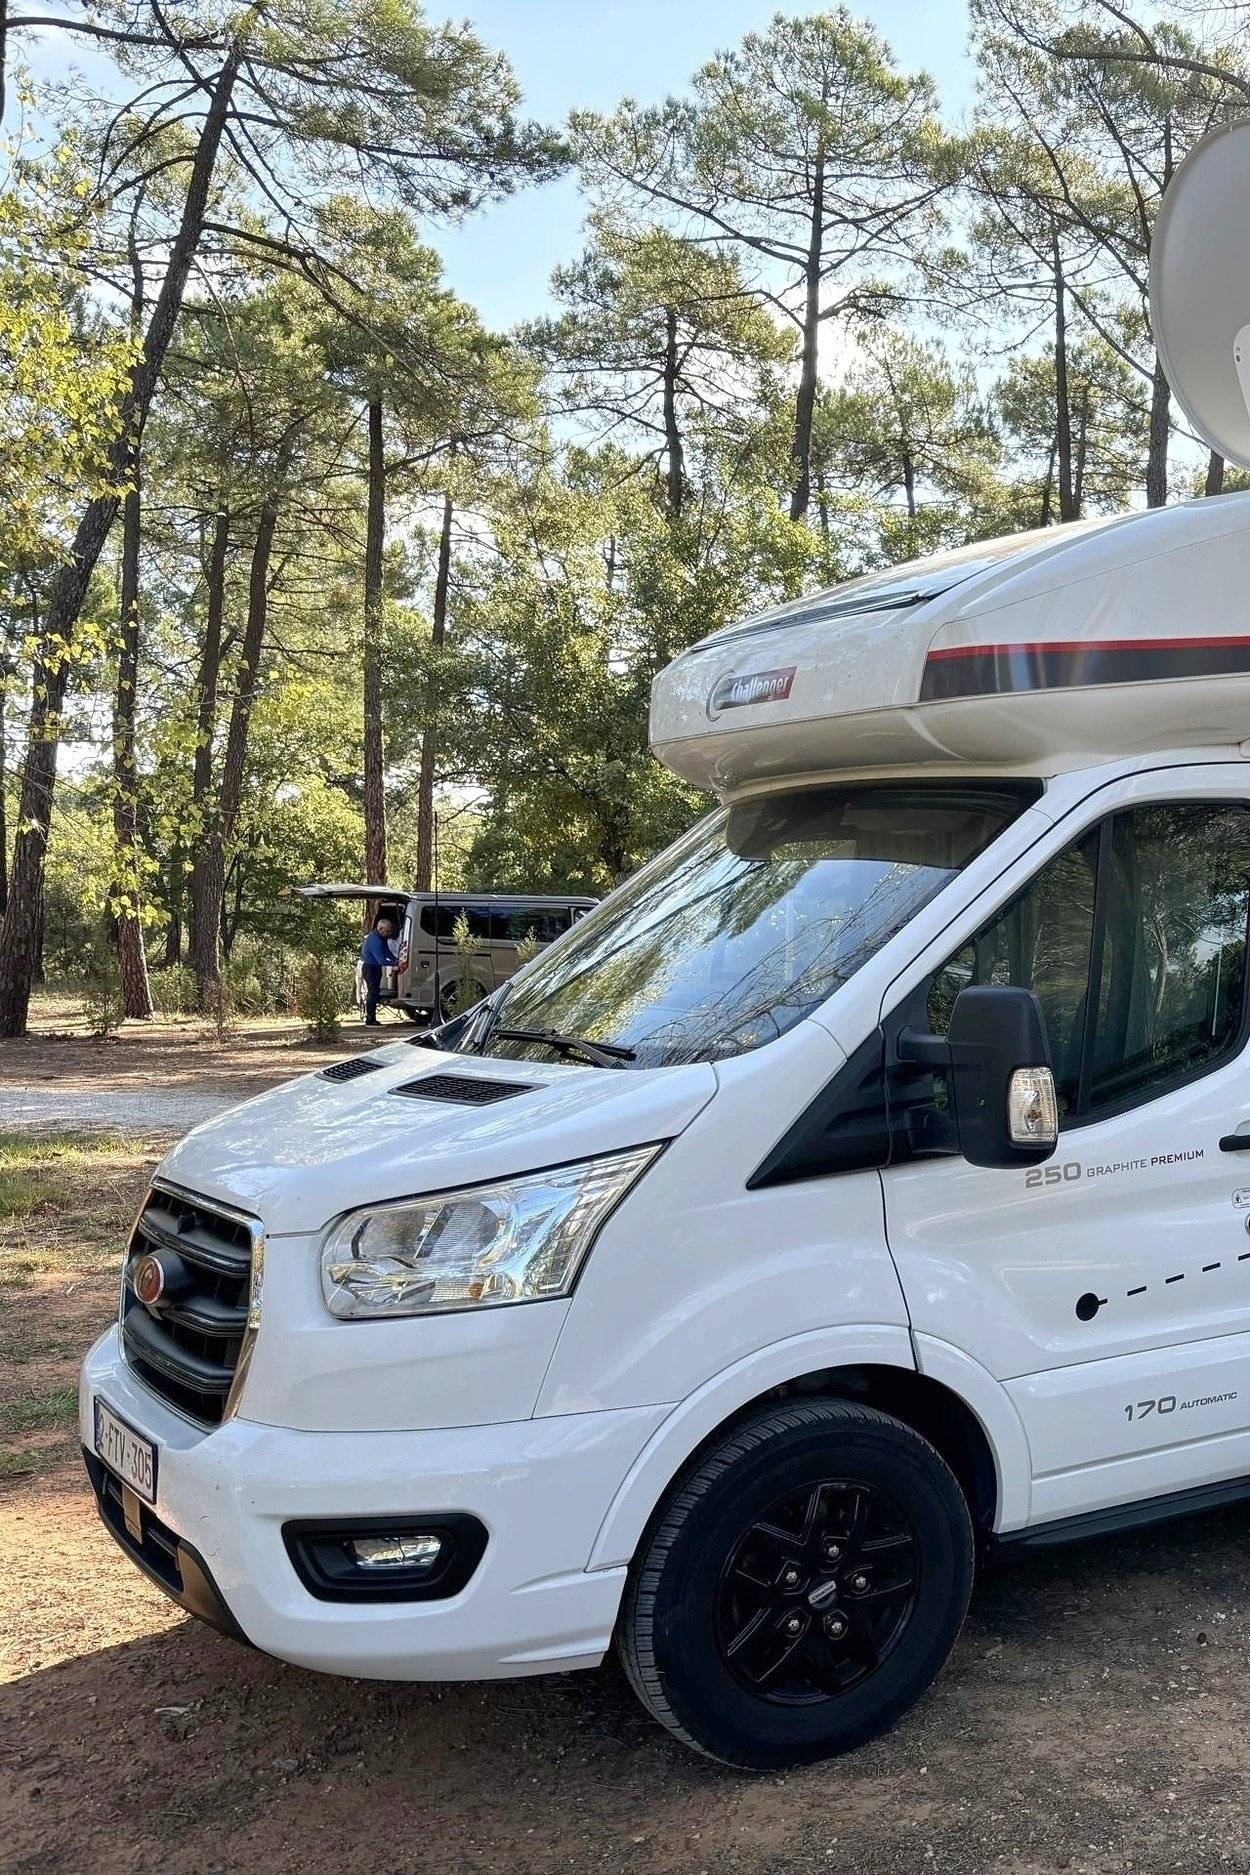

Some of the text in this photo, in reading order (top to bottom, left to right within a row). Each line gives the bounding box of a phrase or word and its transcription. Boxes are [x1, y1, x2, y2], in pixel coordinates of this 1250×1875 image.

[731, 676, 790, 701] Challenger
[1024, 1149, 1204, 1188] 250 GRAPHITE PREMIUM
[1124, 1391, 1239, 1421] 170 AUTOMATIC
